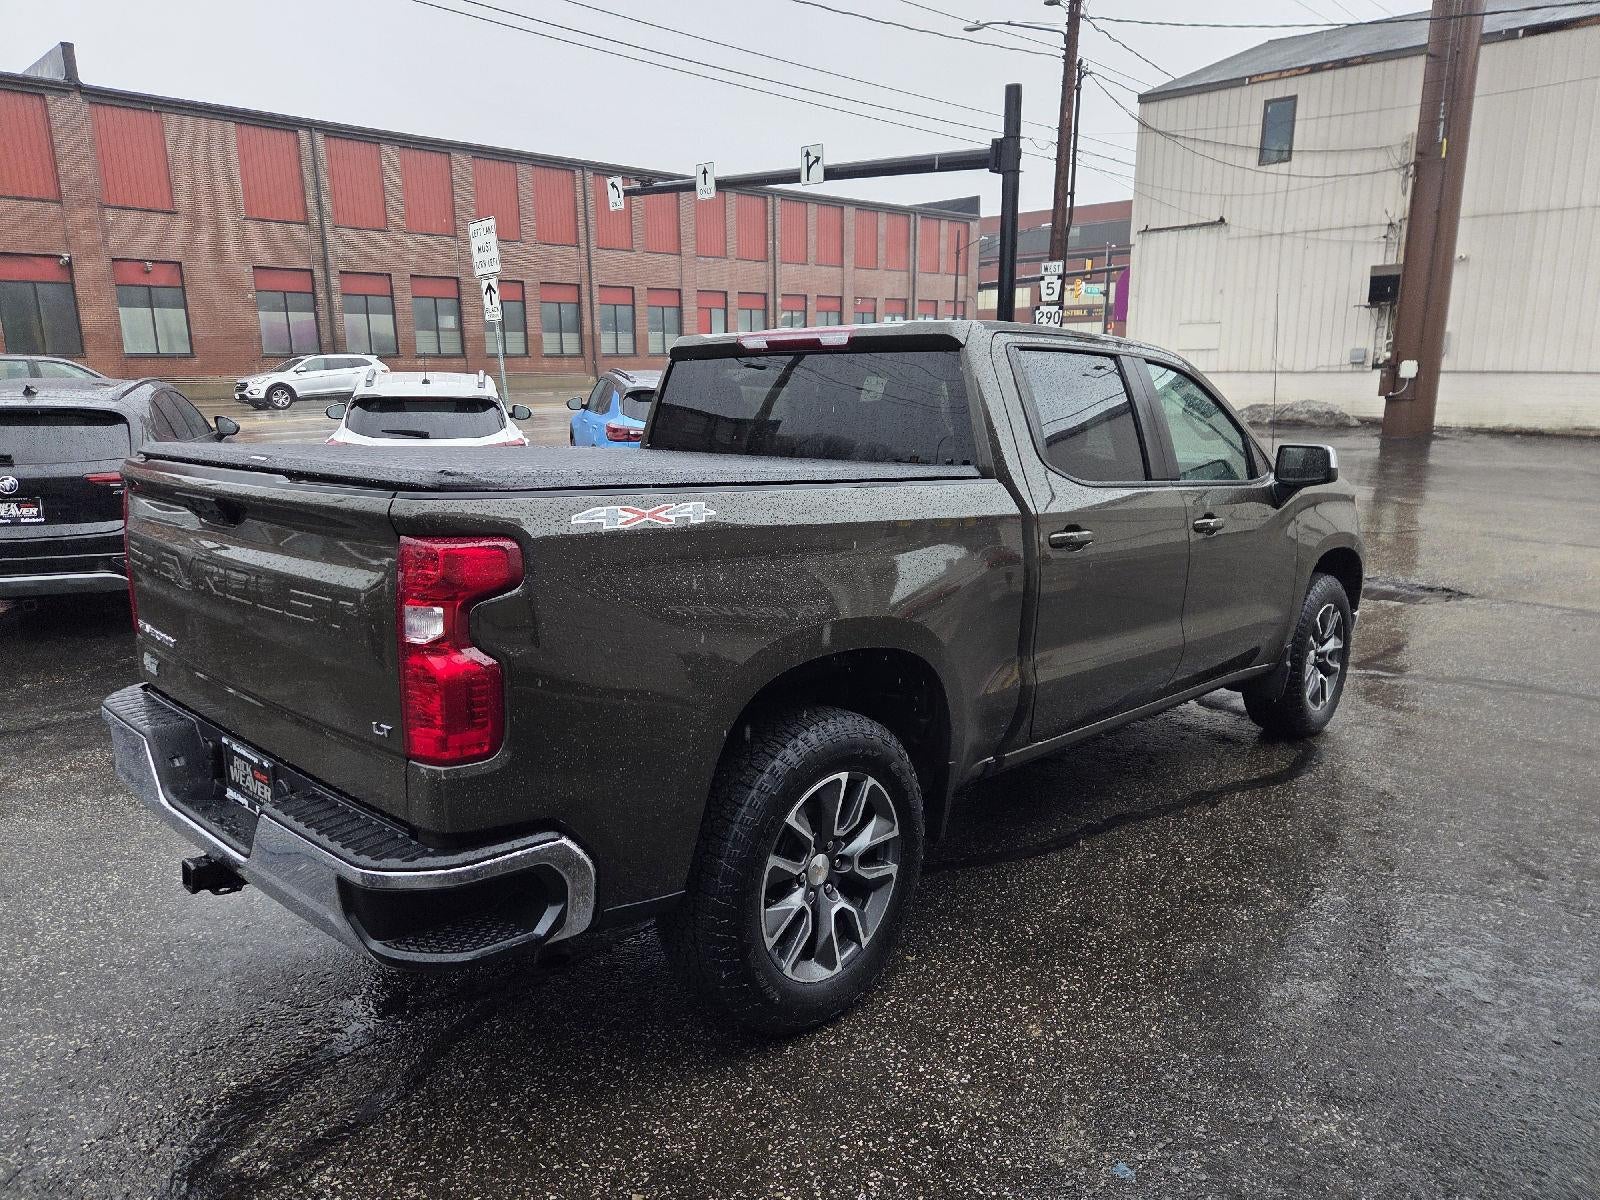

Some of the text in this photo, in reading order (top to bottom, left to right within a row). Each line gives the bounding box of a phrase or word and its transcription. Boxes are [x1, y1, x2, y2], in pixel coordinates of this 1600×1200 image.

[699, 186, 713, 196] ONLY
[611, 200, 623, 208] ONLY
[471, 224, 495, 239] LEFT LANE
[477, 241, 492, 254] MUST
[475, 257, 498, 270] TURN LEFT
[1043, 264, 1061, 273] WEST
[1045, 281, 1055, 297] 5
[1037, 310, 1060, 325] 290
[371, 721, 393, 738] LT
[233, 755, 252, 776] RICK
[229, 764, 273, 803] WEAVER
